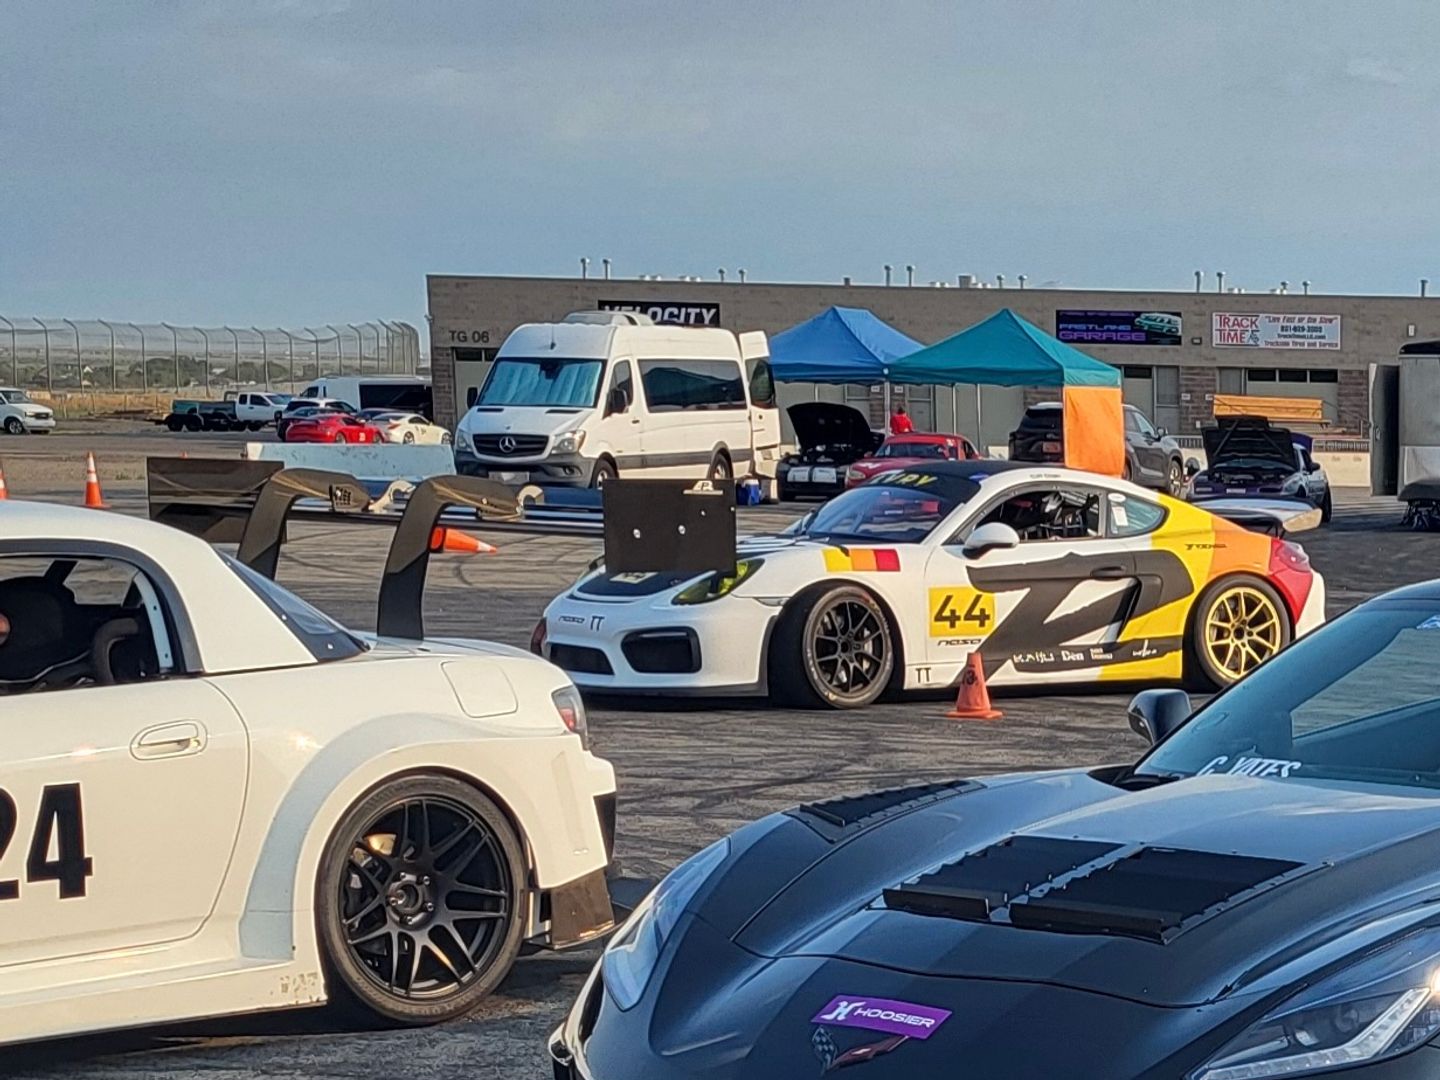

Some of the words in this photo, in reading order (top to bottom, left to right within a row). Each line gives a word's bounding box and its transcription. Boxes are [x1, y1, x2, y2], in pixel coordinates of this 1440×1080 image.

[604, 305, 717, 325] OCITY
[1215, 315, 1259, 328] TRACK
[450, 331, 468, 343] TG
[472, 331, 490, 343] 06
[1058, 331, 1147, 341] GARAGE
[1216, 330, 1245, 343] TIME
[933, 594, 991, 629] 44
[590, 615, 605, 632] TT
[915, 667, 932, 683] TT
[853, 1006, 936, 1029] HOOSIER
